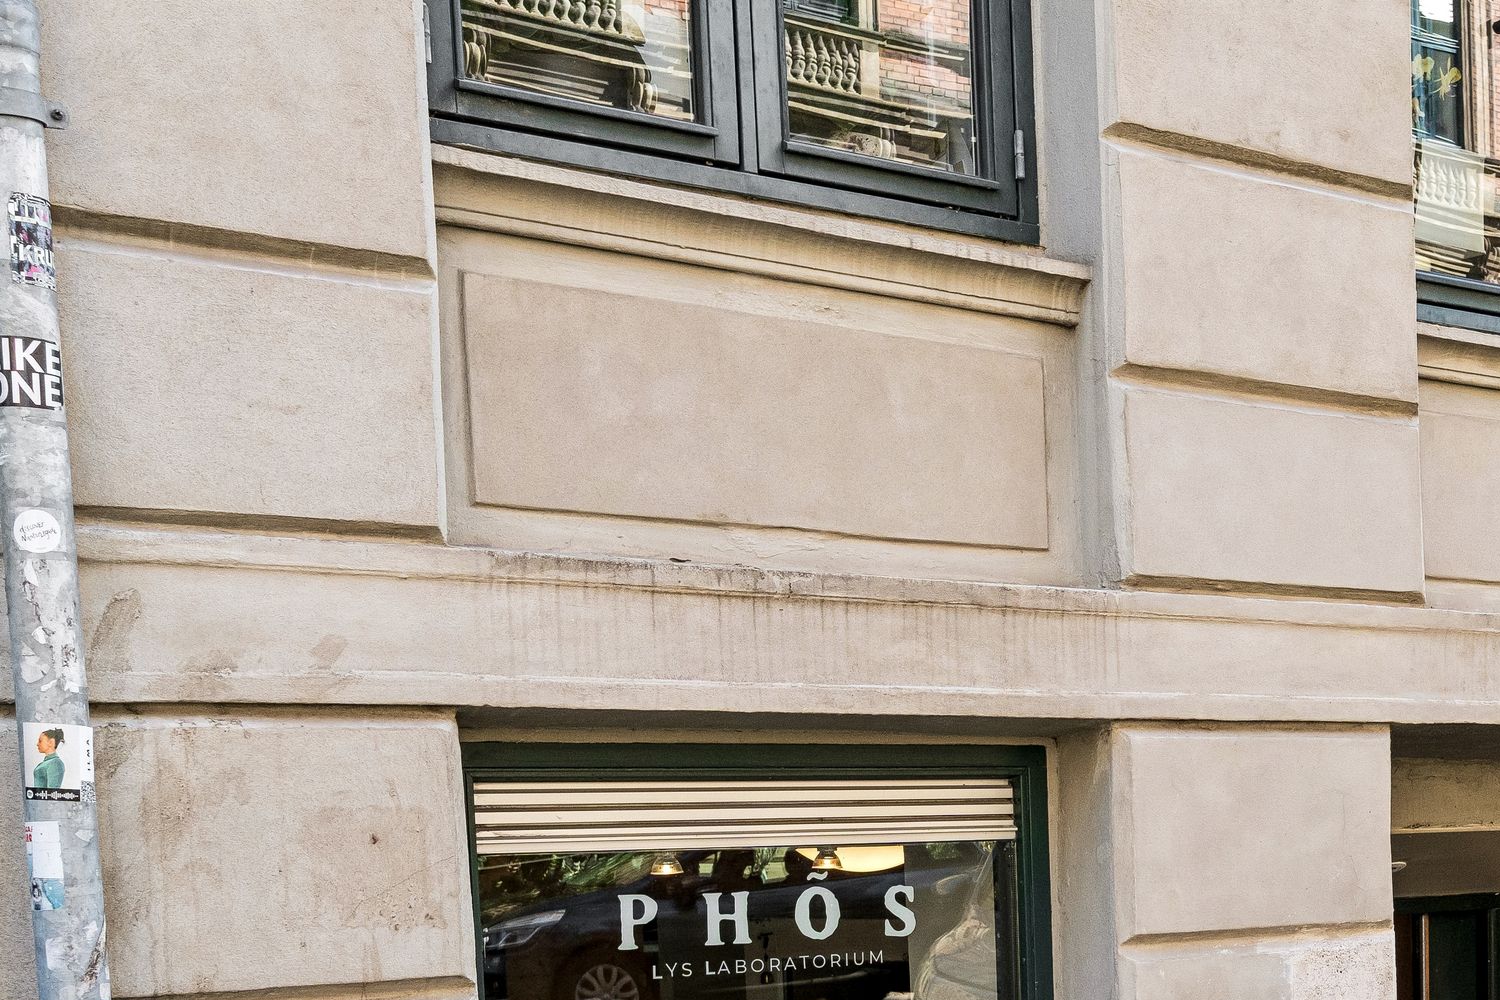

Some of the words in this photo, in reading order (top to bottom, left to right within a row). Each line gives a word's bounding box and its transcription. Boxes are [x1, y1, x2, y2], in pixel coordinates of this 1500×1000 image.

[0, 337, 61, 377] IKE
[652, 962, 693, 980] LYS
[705, 950, 884, 975] LABORATORIUM
